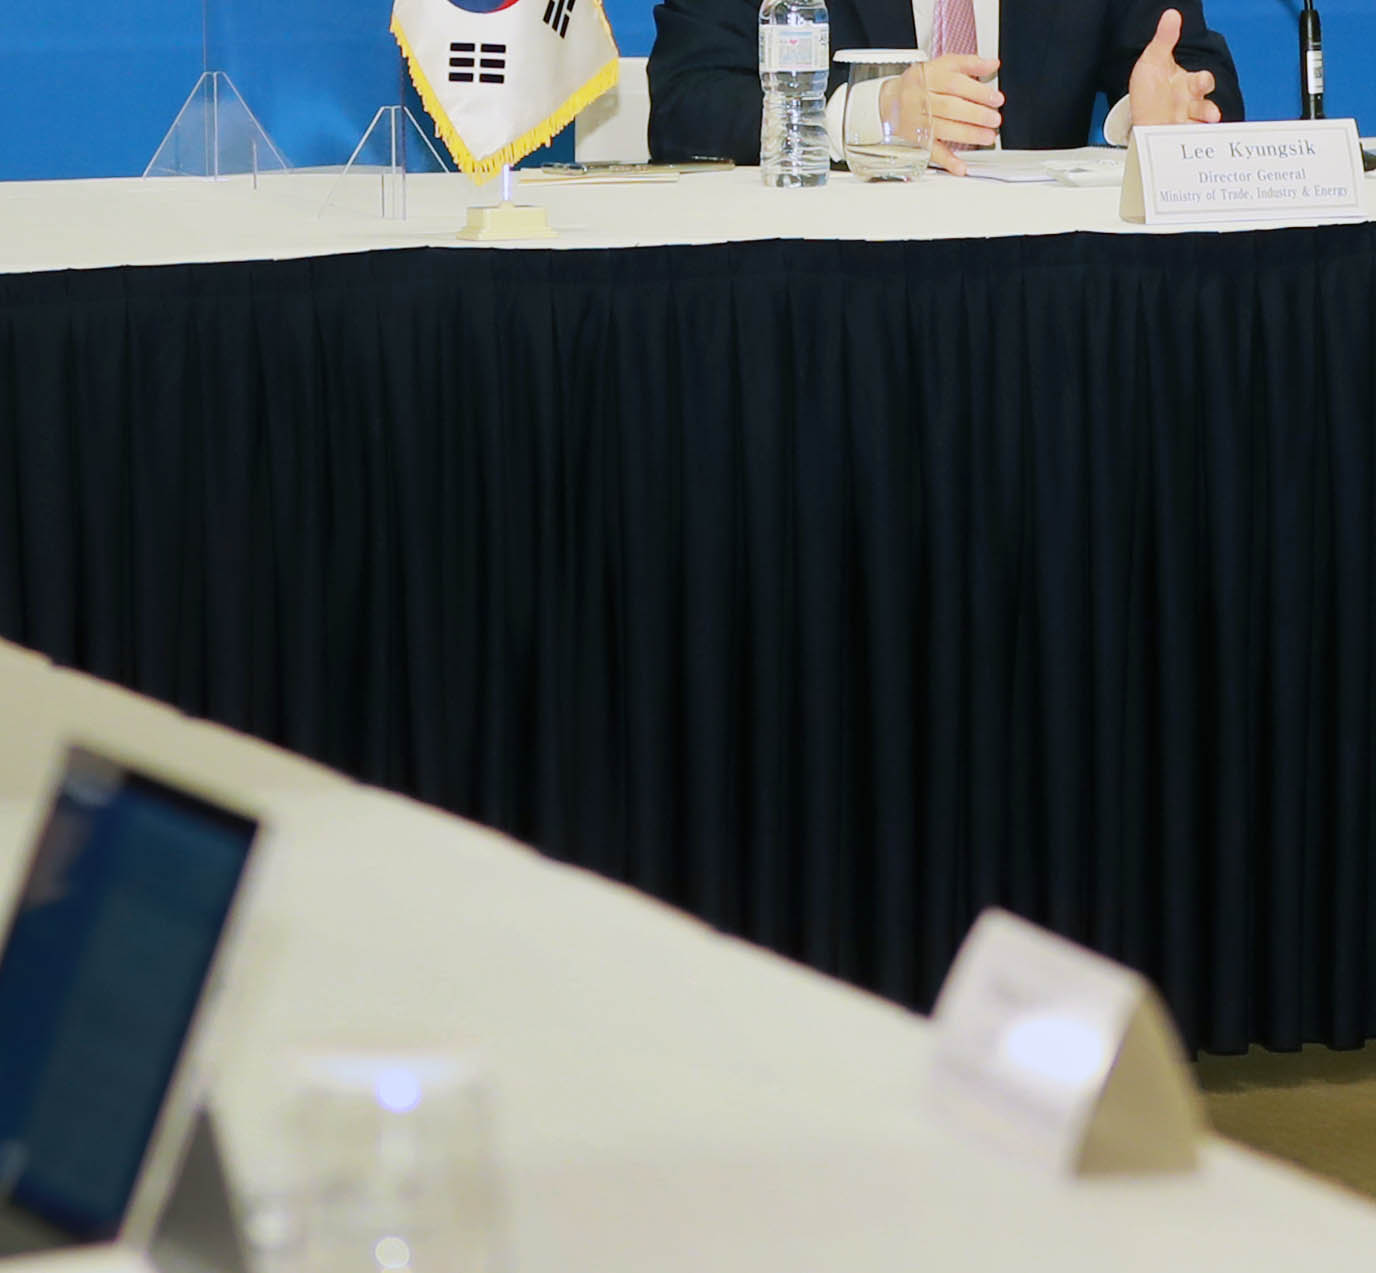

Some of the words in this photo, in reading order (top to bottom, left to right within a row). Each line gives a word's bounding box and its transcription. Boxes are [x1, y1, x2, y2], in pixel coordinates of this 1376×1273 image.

[1181, 143, 1215, 160] Lee
[1229, 139, 1317, 160] Kyungsik
[1198, 170, 1253, 184] Director
[1256, 168, 1306, 182] General
[1160, 189, 1202, 203] Ministry
[1207, 188, 1216, 201] of
[1256, 186, 1297, 200] Industry
[1302, 186, 1310, 197] &
[1314, 184, 1348, 198] Energy
